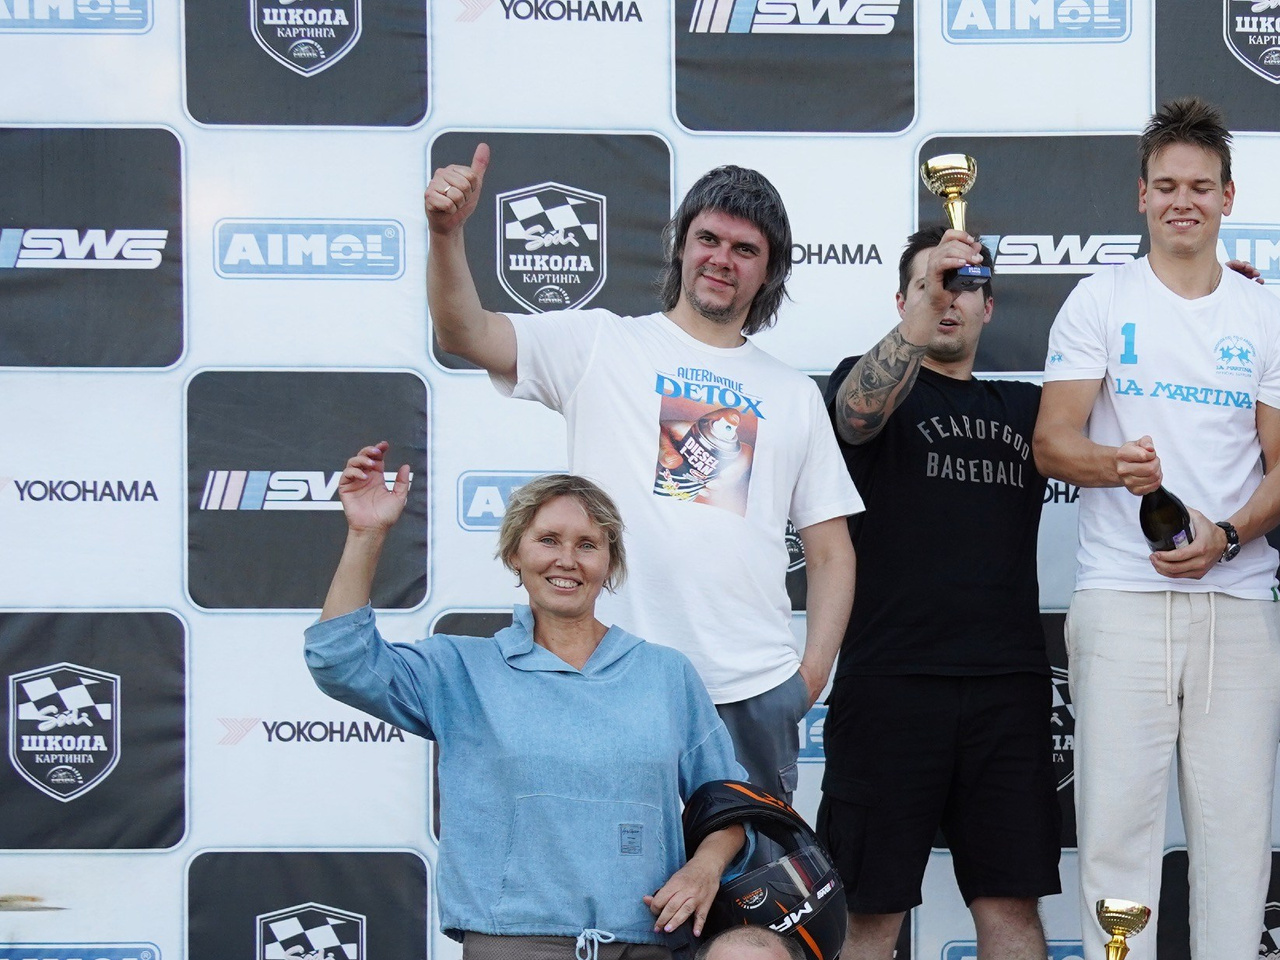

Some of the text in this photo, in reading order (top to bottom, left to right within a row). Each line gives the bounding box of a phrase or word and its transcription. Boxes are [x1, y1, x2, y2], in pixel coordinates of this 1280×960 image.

[264, 9, 349, 25] ШКОЛА
[500, 0, 643, 22] YOKOHAMA
[751, 0, 896, 34] SWS
[952, 0, 1121, 31] AIMOL
[277, 28, 336, 38] КАРТИНГА
[16, 229, 168, 269] SWS
[224, 234, 394, 267] AIMOL
[509, 255, 594, 271] ШКОЛА
[994, 234, 1142, 275] SWS
[522, 273, 581, 284] КАРТИНГА
[1120, 322, 1138, 365] 1
[677, 366, 744, 394] ALTERNATIVE
[1115, 378, 1253, 410] LA MARTINA
[654, 373, 767, 421] DETOX
[685, 436, 719, 470] DIESEL
[926, 451, 1024, 488] BASEBALL
[14, 480, 159, 502] YOKOHAMA
[22, 735, 108, 751] ШКОЛА
[262, 721, 405, 744] YOKOHAMA
[35, 754, 94, 764] КАРТИНГА
